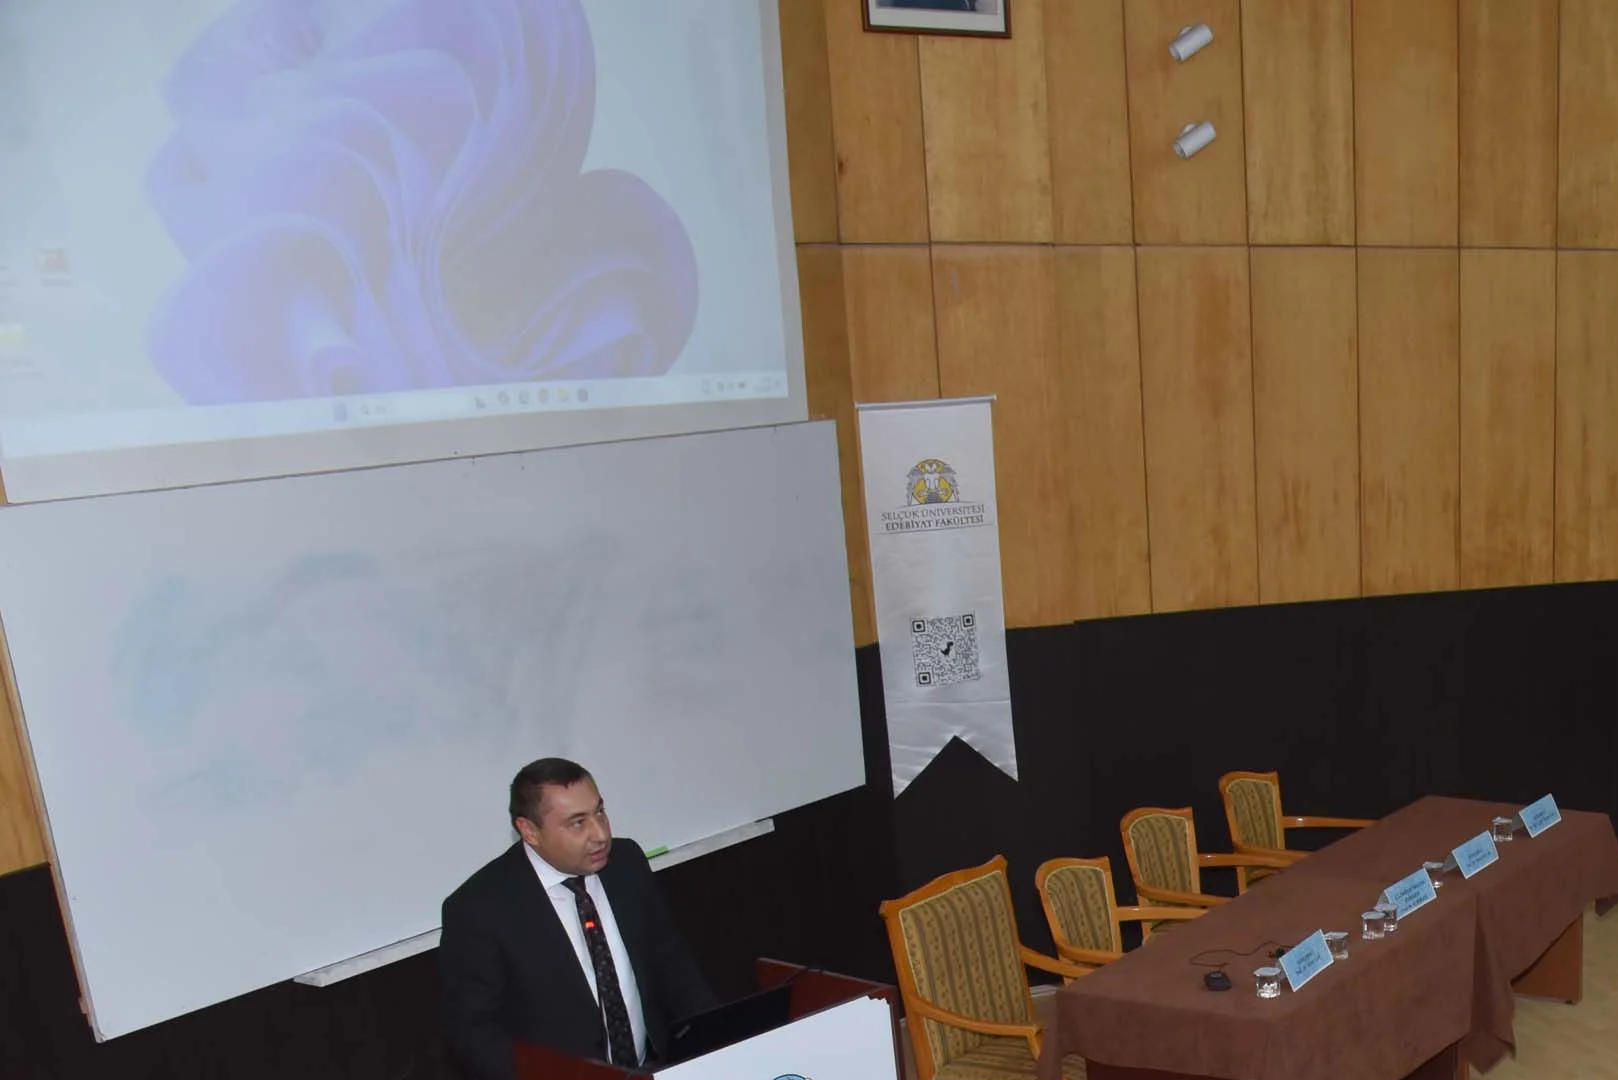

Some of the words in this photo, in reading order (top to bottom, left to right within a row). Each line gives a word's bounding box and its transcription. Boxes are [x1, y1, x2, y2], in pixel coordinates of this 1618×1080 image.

[881, 510, 920, 521] SELÇUK
[921, 504, 985, 518] ÜNİVERSİTESİ
[886, 519, 933, 531] EDEBİYAT
[935, 514, 984, 528] FAKÜLTESİ
